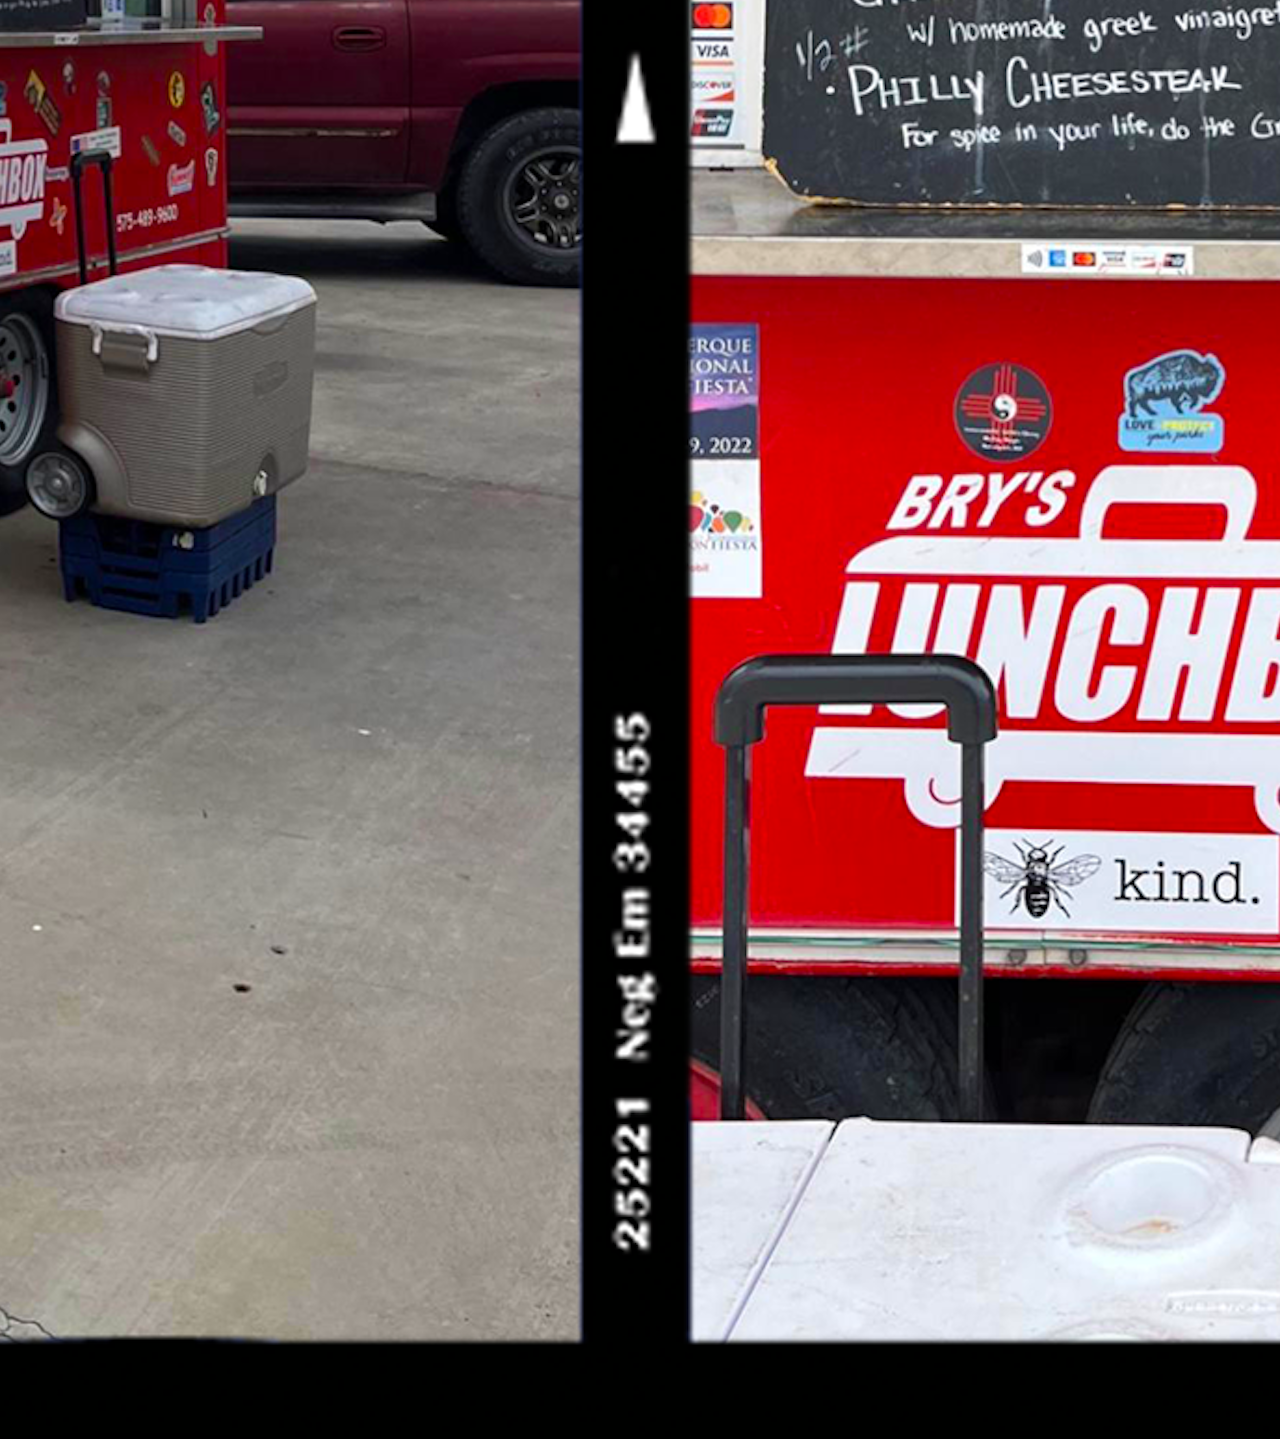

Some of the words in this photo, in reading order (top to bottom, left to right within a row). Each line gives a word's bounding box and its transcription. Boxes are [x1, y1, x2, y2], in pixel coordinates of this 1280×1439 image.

[696, 44, 729, 57] VISA
[949, 16, 1066, 44] homemade
[1085, 13, 1158, 52] greek
[848, 64, 985, 116] PHILLY
[1006, 56, 1242, 108] CHEESESTEAK
[902, 122, 938, 149] For
[951, 124, 1001, 152] spice
[1016, 121, 1037, 141] in
[1047, 124, 1102, 151] your
[1161, 118, 1190, 141] do
[1203, 117, 1235, 139] the
[709, 437, 752, 454] 2022
[887, 470, 1075, 531] BRY'S
[1114, 859, 1261, 905] kind.
